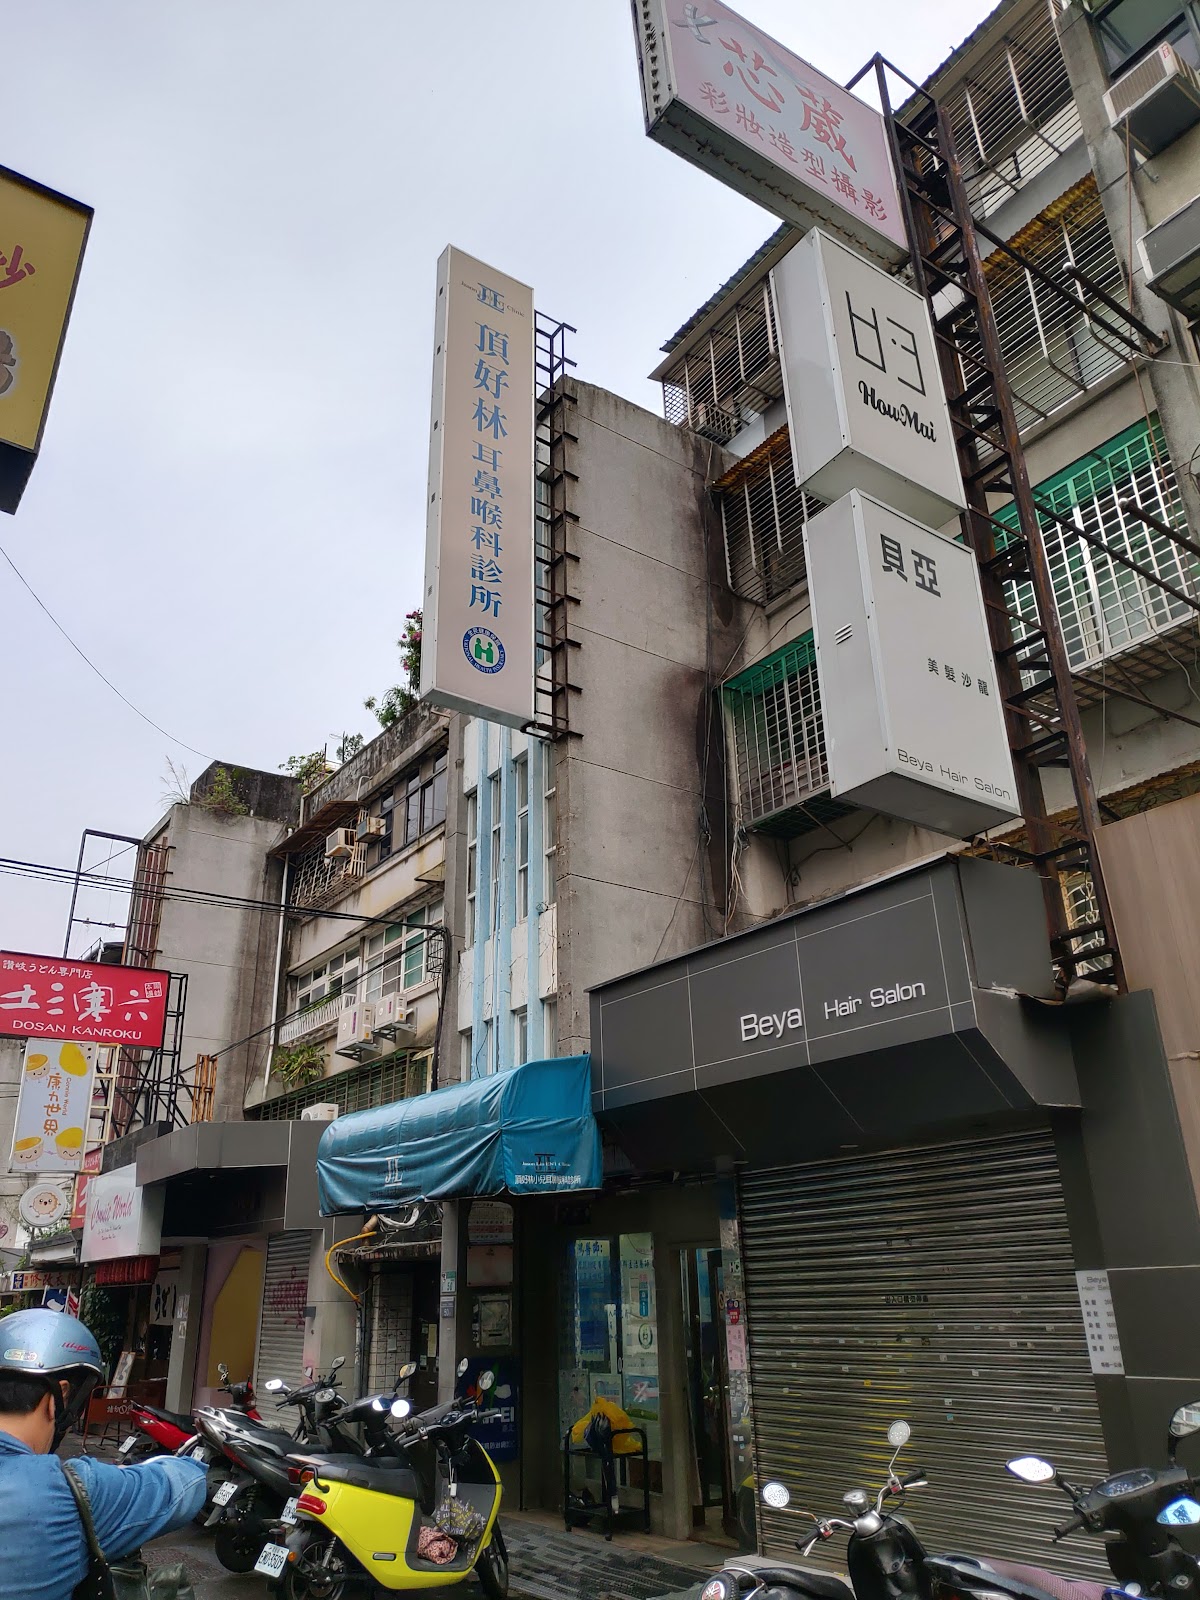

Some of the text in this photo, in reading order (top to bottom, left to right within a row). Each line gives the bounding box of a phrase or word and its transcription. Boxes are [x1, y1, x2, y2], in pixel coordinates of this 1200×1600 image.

[698, 80, 888, 222] 彩妝造型攝影
[469, 321, 510, 618] 頂好林耳鼻喉科診所
[880, 533, 942, 598] 貝亞
[897, 748, 1011, 801] Beya Hair Salon
[12, 1019, 143, 1041] DOSAN KANROKU
[739, 979, 927, 1042] Beya Hair Salon
